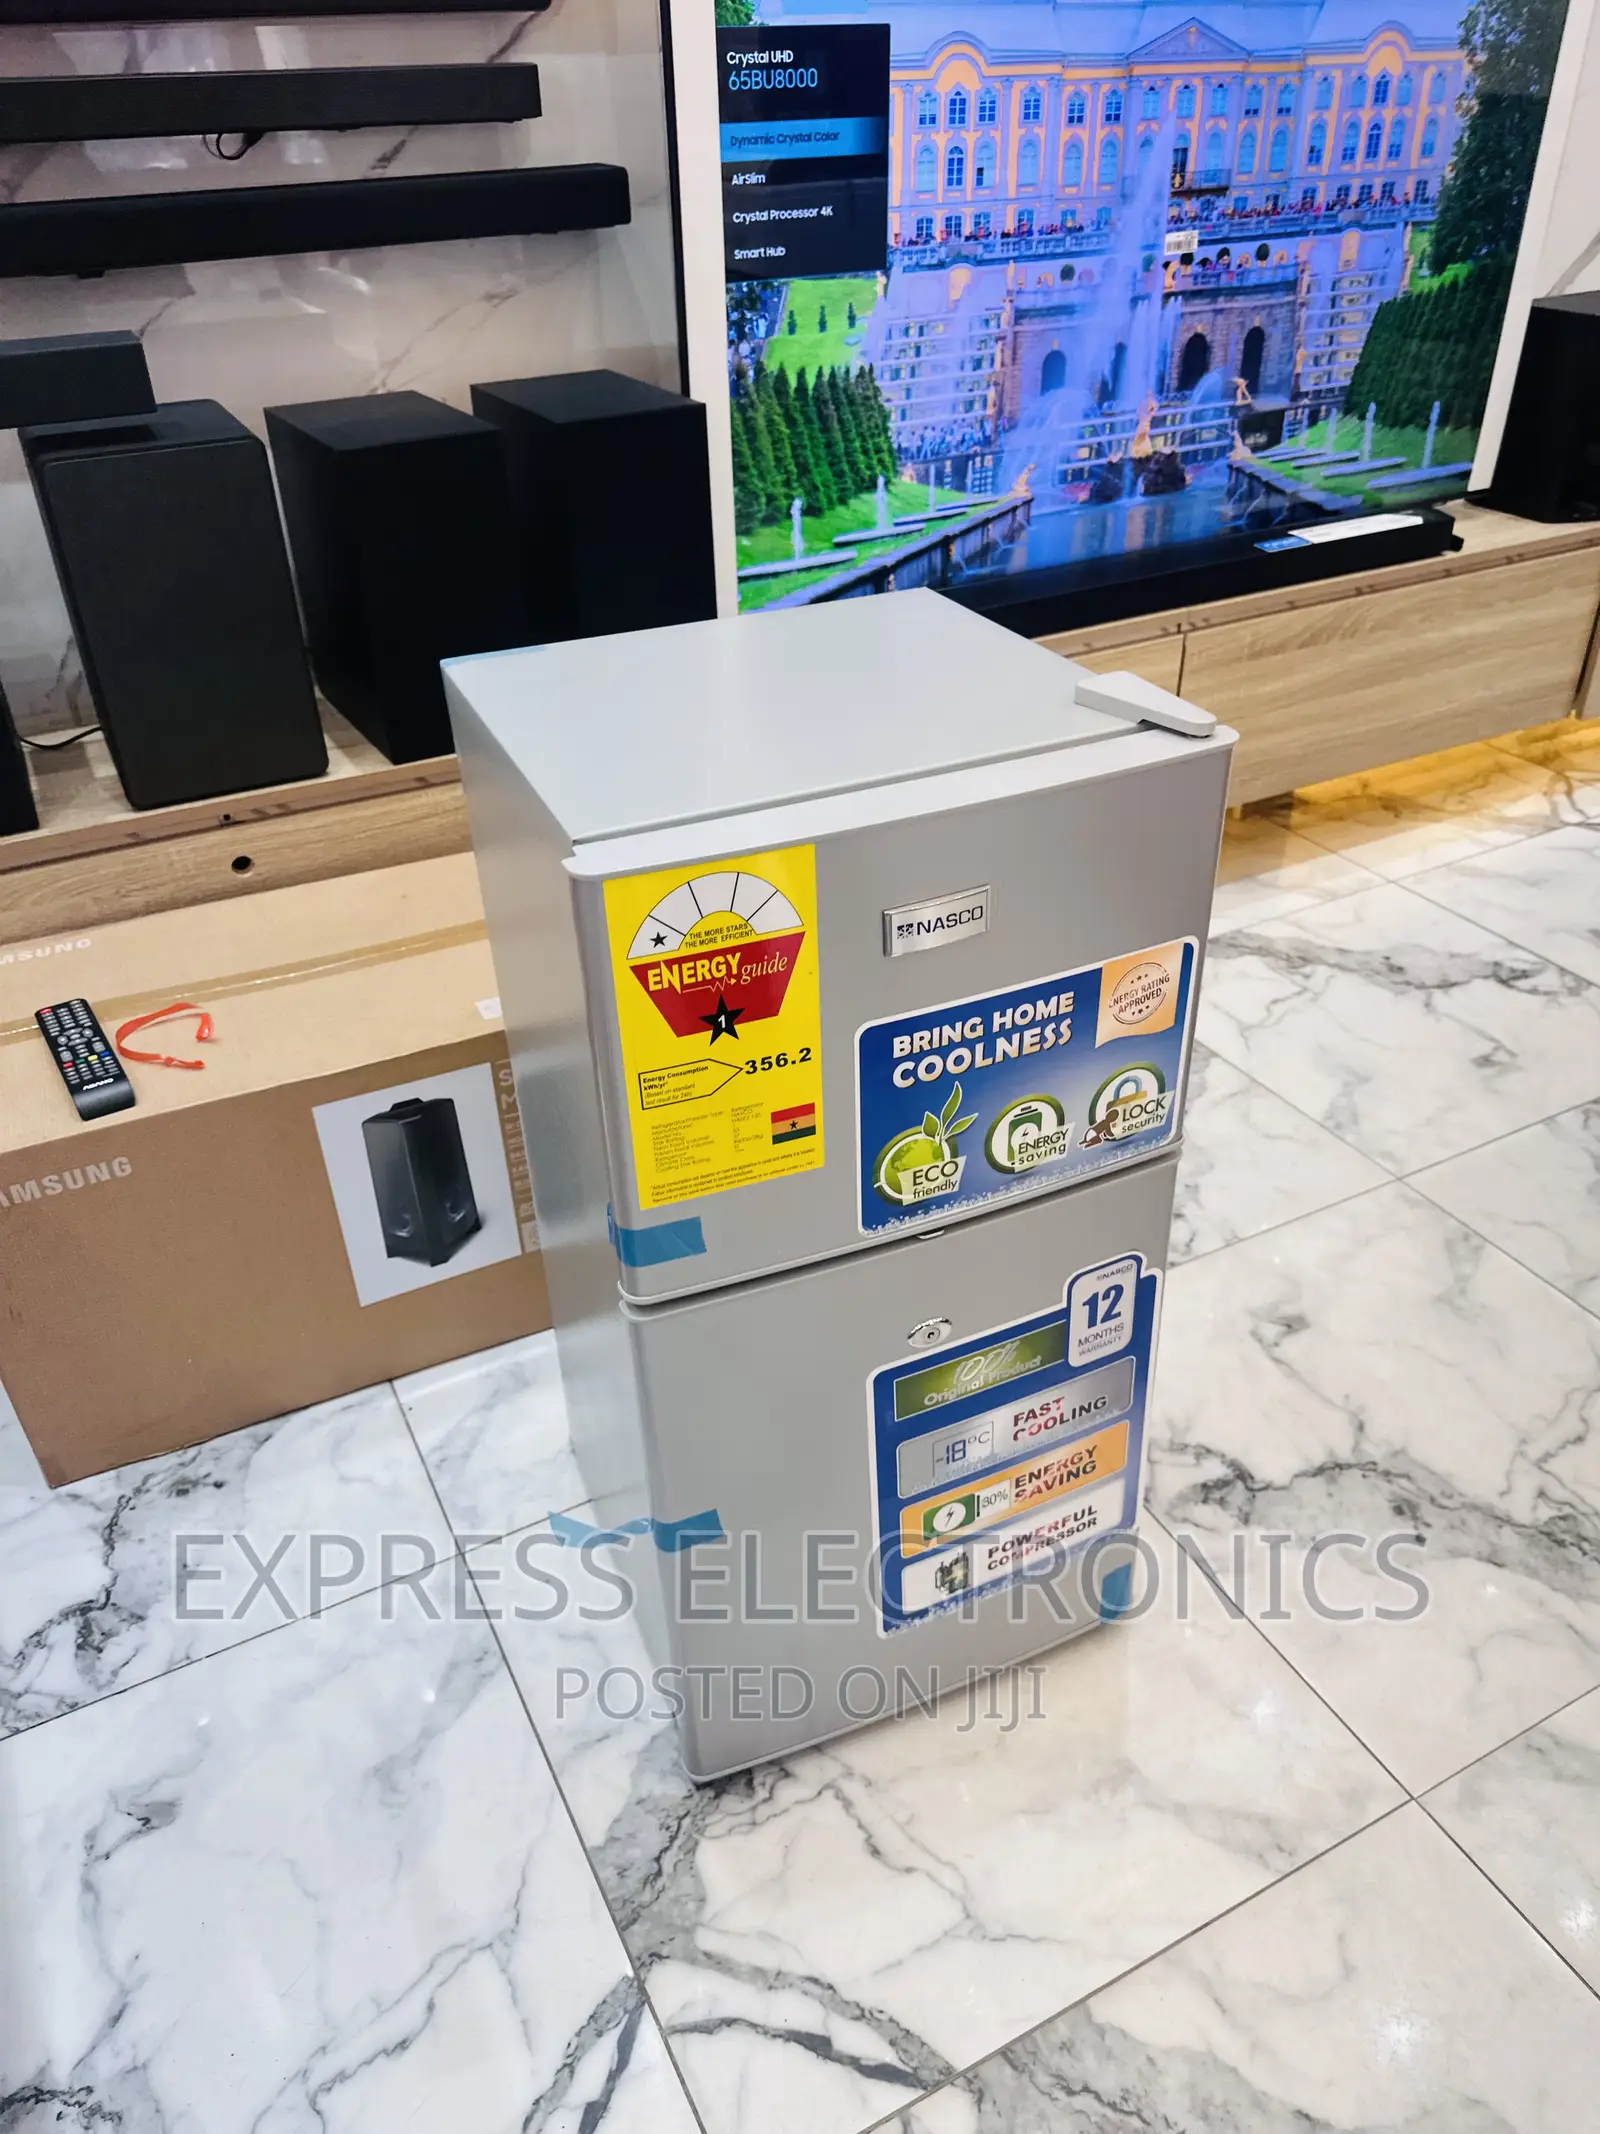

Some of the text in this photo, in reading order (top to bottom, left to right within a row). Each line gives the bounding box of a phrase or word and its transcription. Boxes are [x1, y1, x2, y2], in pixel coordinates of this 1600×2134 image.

[726, 50, 794, 68] Crystal UHD
[728, 68, 818, 91] 65BU8000
[730, 131, 840, 149] Dynamic Crystal Color
[732, 172, 766, 186] AirSlim
[732, 205, 834, 225] Crystal Processor 4K
[734, 246, 787, 260] Smart Hub
[689, 923, 748, 940] THE MORE STARS
[917, 905, 983, 936] NASCO
[685, 930, 754, 949] THE MORE EFFICIENT
[647, 951, 788, 994] ENERGY guide
[1141, 973, 1170, 993] RATING
[1118, 987, 1162, 1014] APPROVED
[717, 1014, 726, 1029] 1
[892, 991, 1075, 1059] BRING HOME
[744, 1047, 812, 1076] 356.2
[892, 1018, 1073, 1089] COOLNESS
[643, 1065, 709, 1084] Energy Consumption
[1121, 1112, 1167, 1134] security
[1122, 1096, 1167, 1123] LOCK
[1018, 1128, 1070, 1155] ENERGY
[1018, 1143, 1067, 1166] saving
[913, 1160, 959, 1187] ECO
[913, 1179, 958, 1200] friendly
[1082, 1284, 1124, 1329] 12
[1078, 1322, 1124, 1347] MONTHS
[1079, 1336, 1122, 1356] WARRANTY
[924, 1354, 1042, 1406] Original Product
[1012, 1396, 1107, 1442] COOLING
[1013, 1396, 1065, 1428] FAST
[1014, 1445, 1098, 1489] ENERGY
[1014, 1460, 1097, 1503] SAVING
[987, 1517, 1097, 1571] COMPRESSOR
[988, 1505, 1097, 1559] POWERFUL
